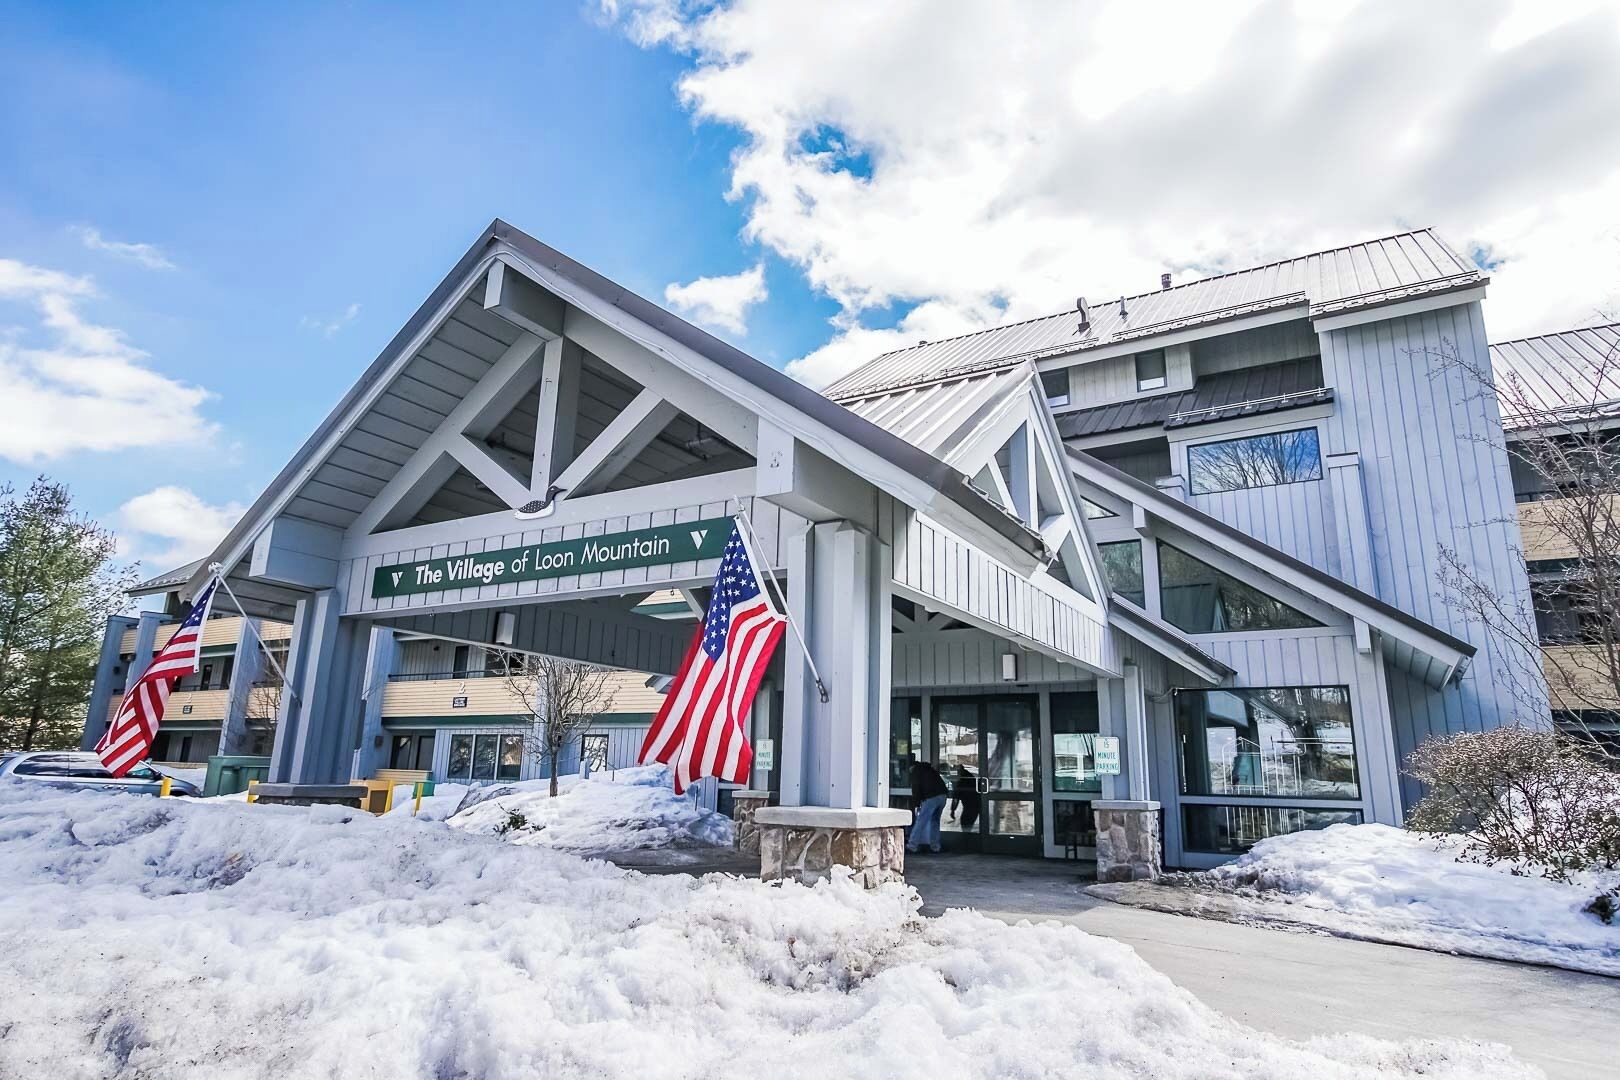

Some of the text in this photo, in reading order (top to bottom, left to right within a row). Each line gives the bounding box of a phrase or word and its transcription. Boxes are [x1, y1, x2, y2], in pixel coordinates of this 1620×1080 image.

[415, 563, 443, 585] The
[447, 557, 505, 584] Village
[511, 550, 529, 573] of
[535, 548, 574, 571] Loon
[580, 535, 670, 565] Mountain
[1096, 762, 1119, 770] PARKING
